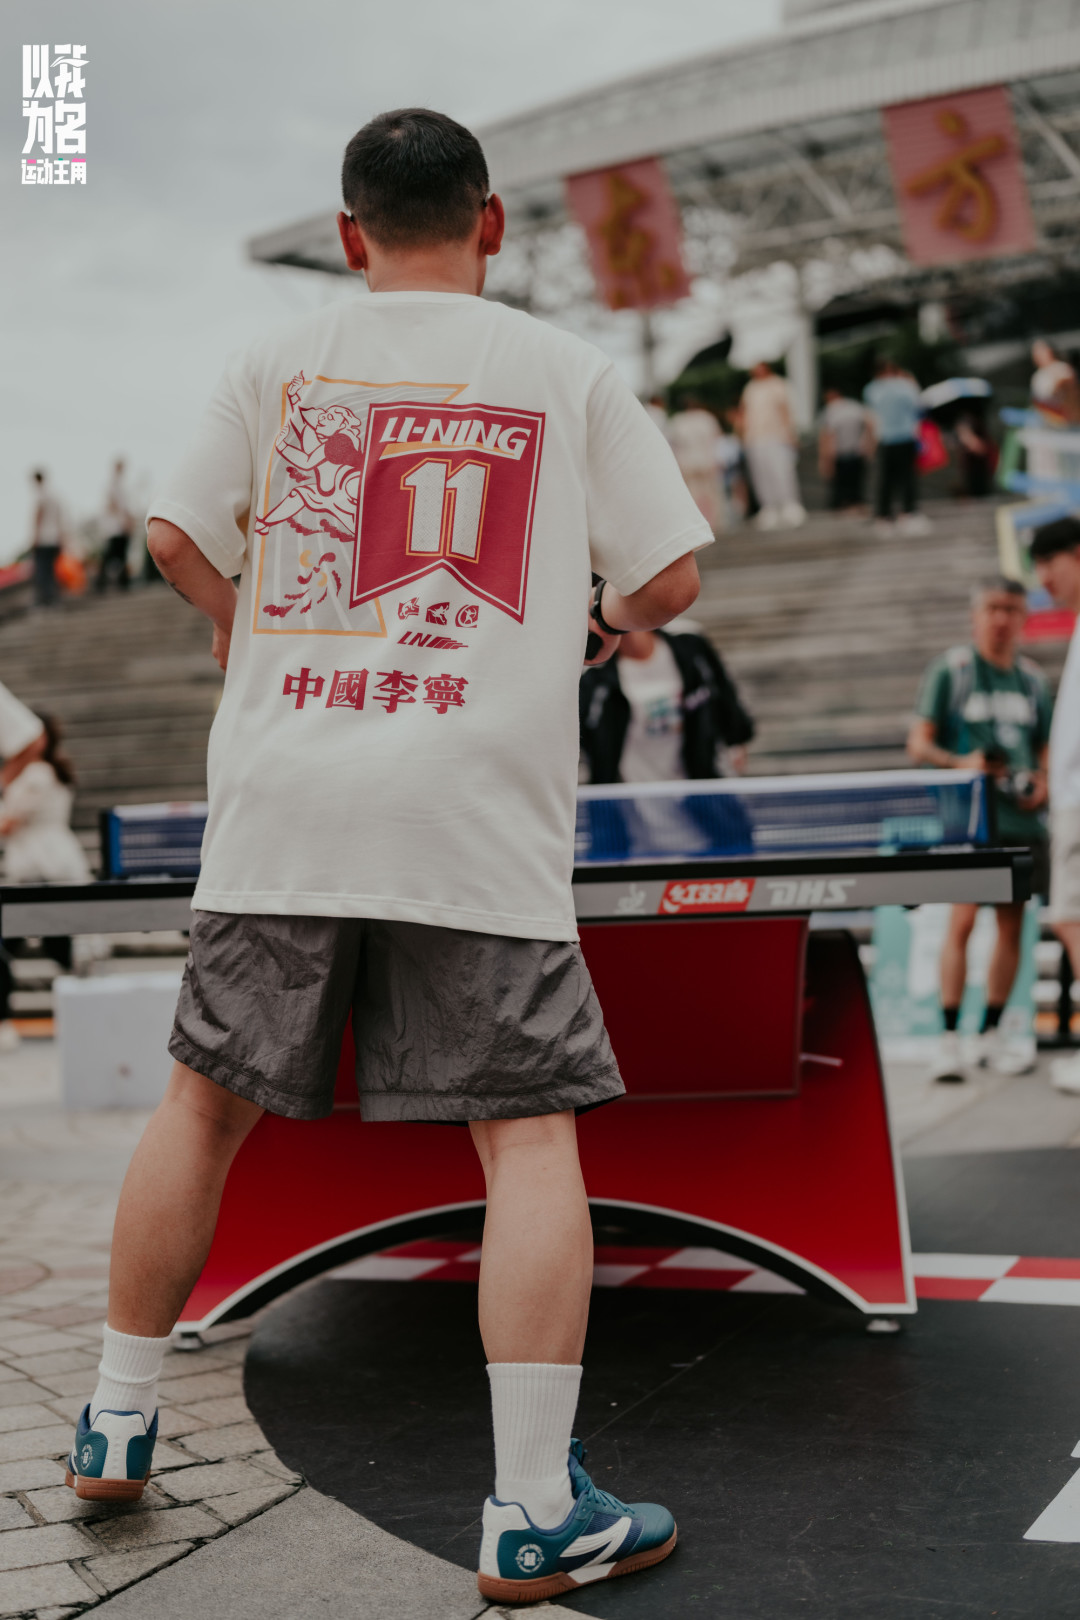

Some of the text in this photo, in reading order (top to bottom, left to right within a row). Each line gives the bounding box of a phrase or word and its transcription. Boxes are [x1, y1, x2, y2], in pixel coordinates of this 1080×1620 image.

[379, 417, 532, 461] LI-NING
[400, 457, 491, 564] 11
[283, 667, 469, 714] 中國李寧
[767, 879, 857, 906] DHS
